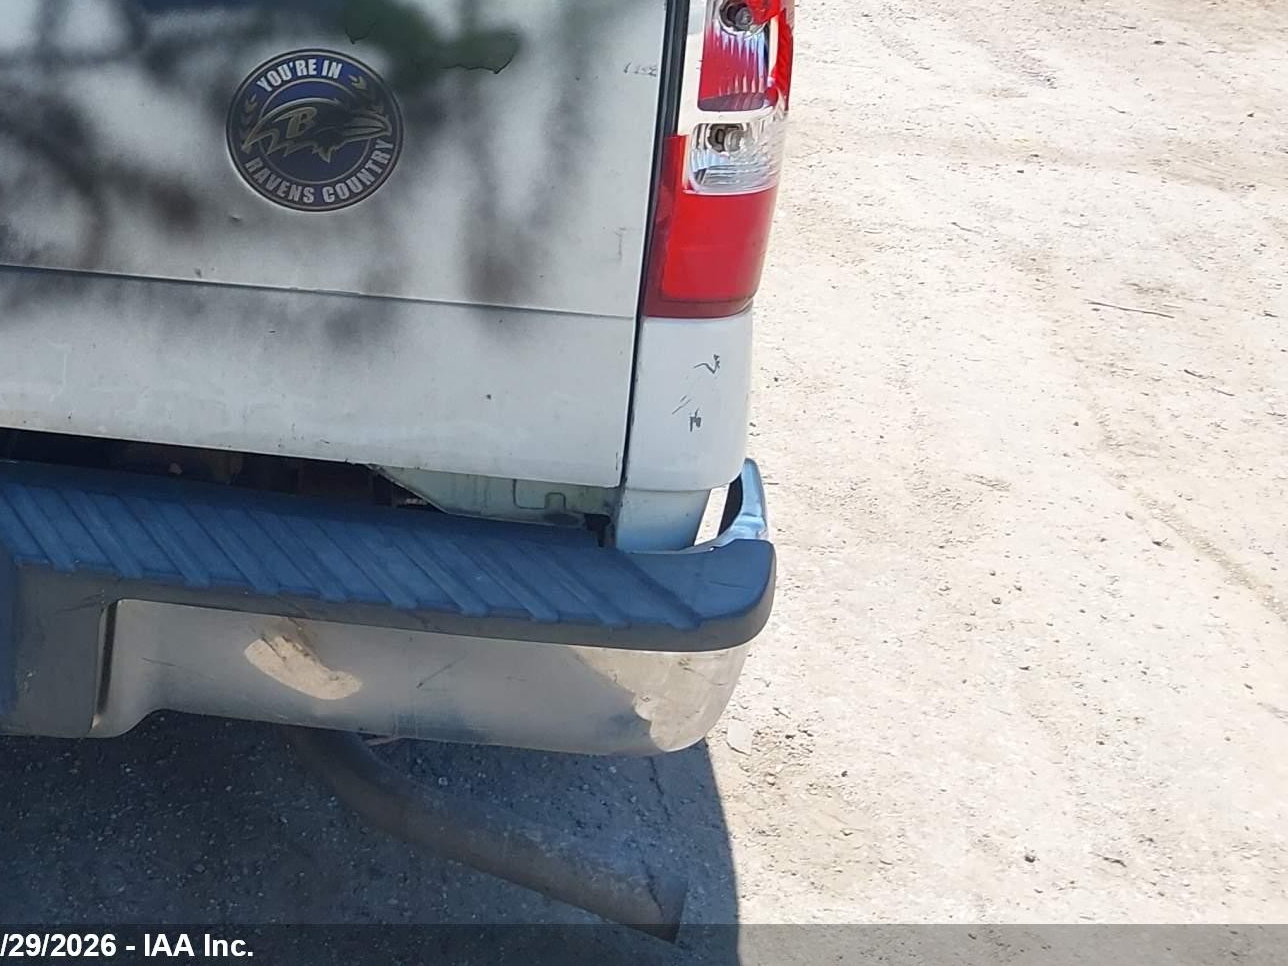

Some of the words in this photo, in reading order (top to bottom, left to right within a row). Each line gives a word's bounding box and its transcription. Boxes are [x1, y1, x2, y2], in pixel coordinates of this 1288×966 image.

[255, 58, 317, 92] YOU'RE
[321, 59, 343, 79] IN
[244, 156, 316, 204] RAVENS
[321, 138, 395, 204] COUNTRY
